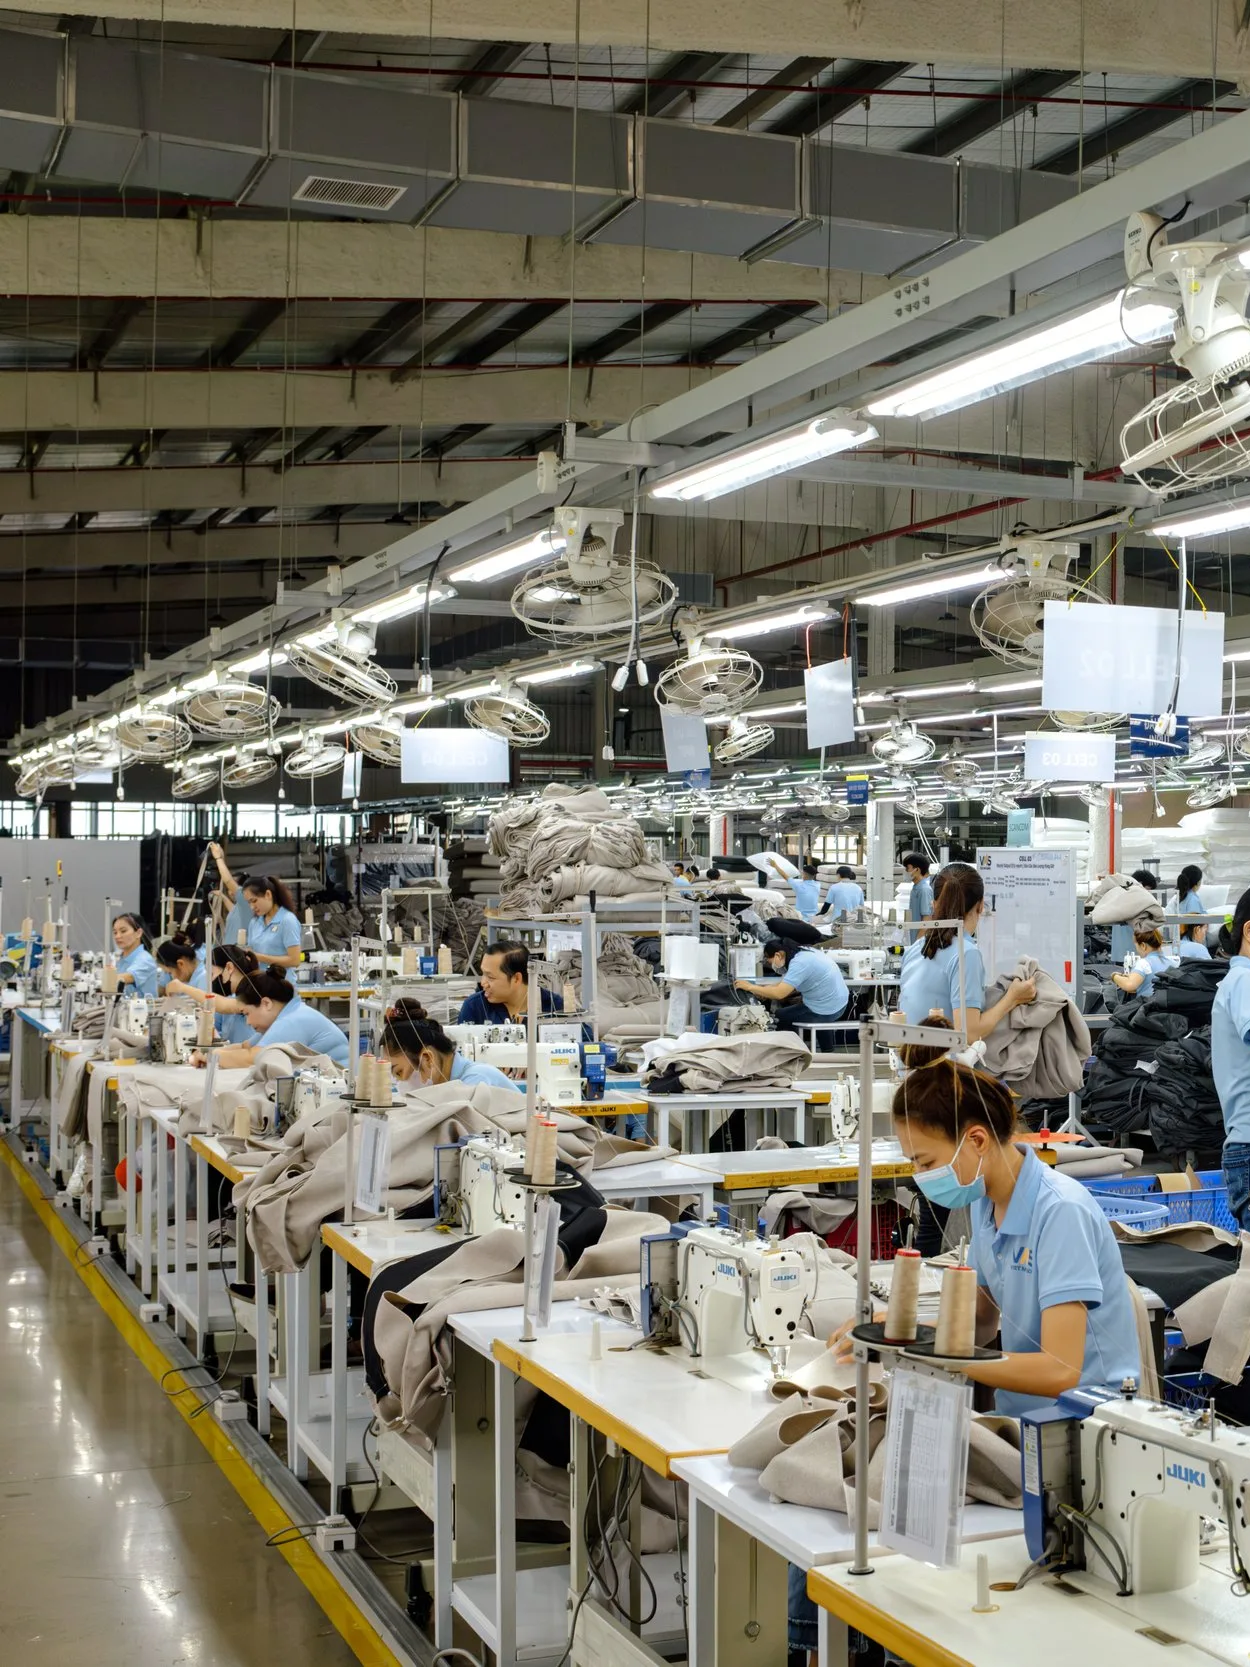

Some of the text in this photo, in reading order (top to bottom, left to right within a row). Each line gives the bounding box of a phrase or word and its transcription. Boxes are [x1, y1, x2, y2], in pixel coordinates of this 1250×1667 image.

[718, 1263, 736, 1277] JUKI
[773, 1274, 797, 1282] JUKI
[1166, 1463, 1206, 1488] JUKI
